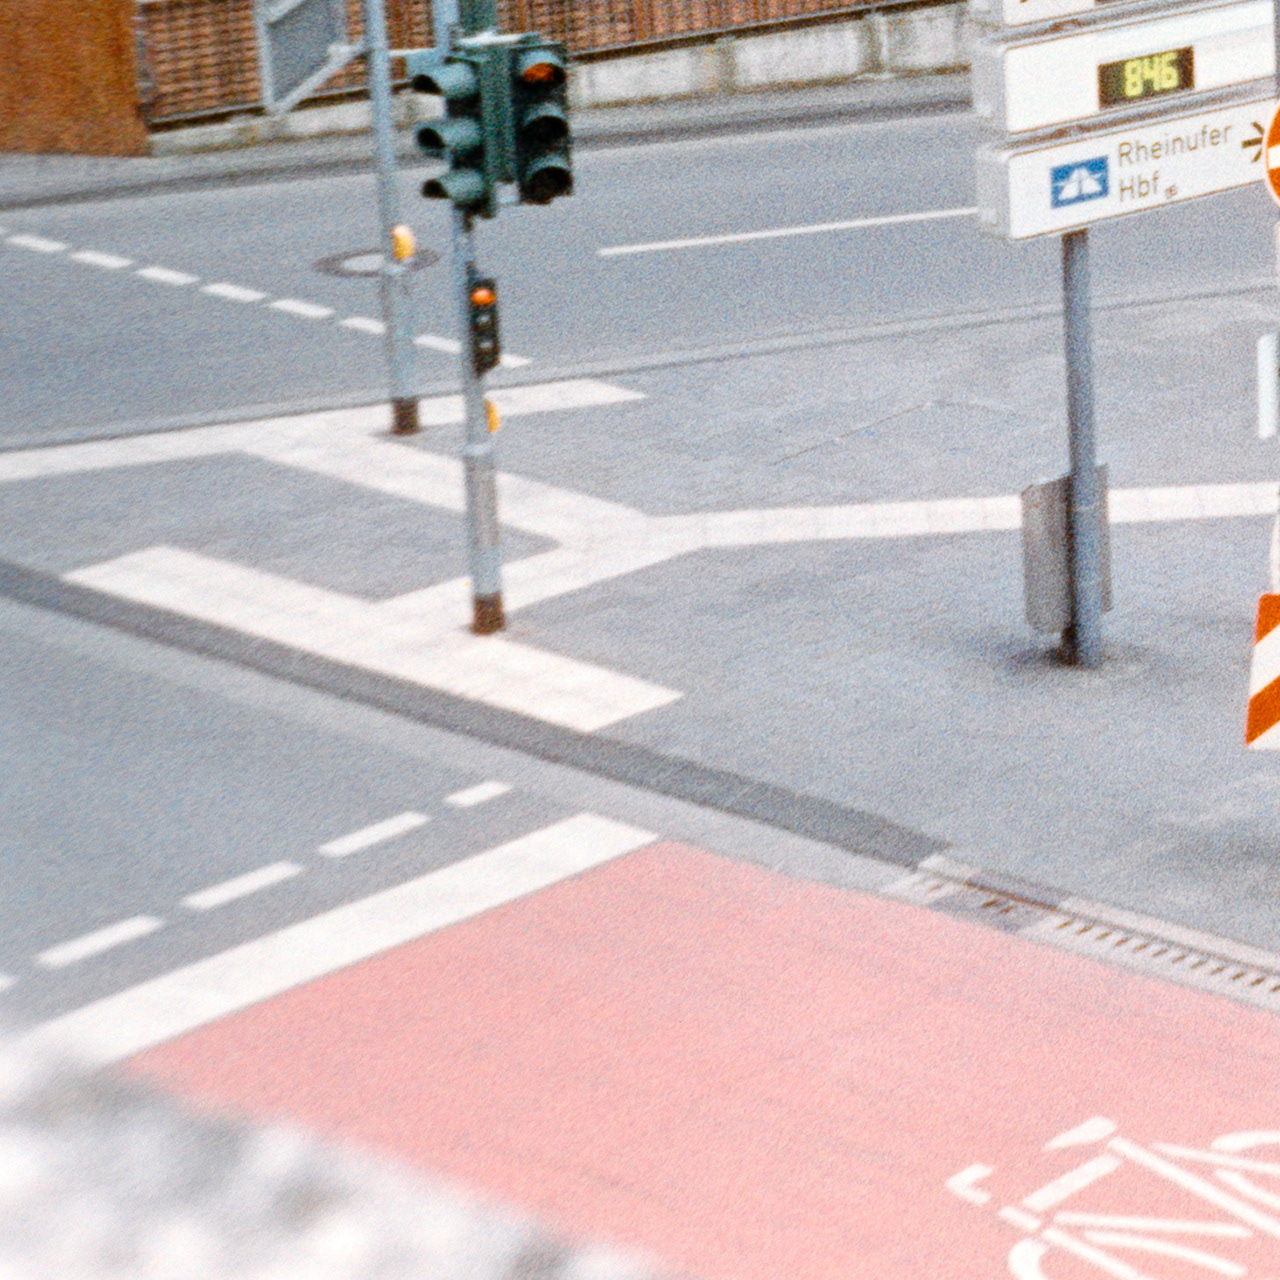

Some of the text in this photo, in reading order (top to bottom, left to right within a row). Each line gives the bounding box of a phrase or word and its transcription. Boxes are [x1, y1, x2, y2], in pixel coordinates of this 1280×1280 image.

[1124, 52, 1179, 98] 846
[1117, 124, 1232, 165] Rheinufer
[1118, 170, 1160, 202] Hbf
